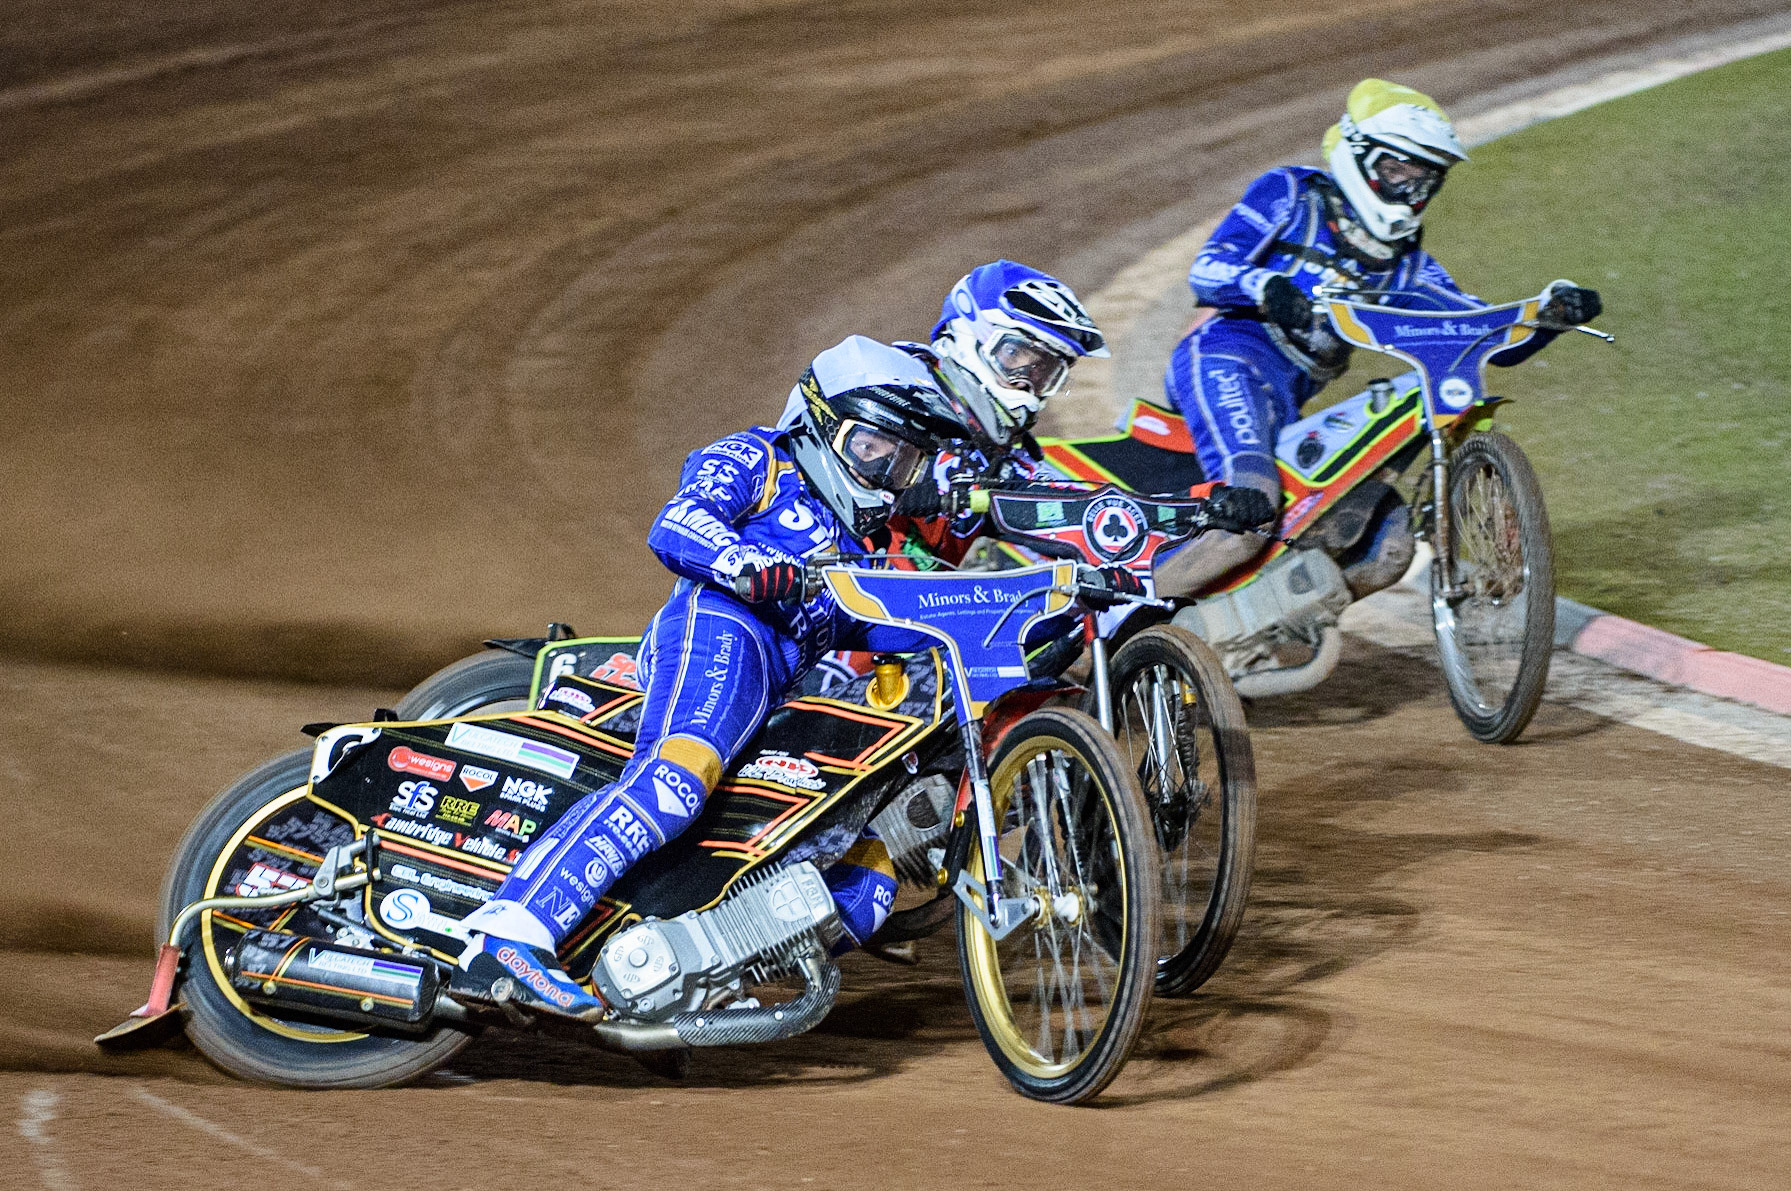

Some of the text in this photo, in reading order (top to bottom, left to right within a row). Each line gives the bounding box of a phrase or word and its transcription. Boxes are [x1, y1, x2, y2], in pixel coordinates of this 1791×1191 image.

[918, 585, 1029, 609] Minors & Brad
[713, 630, 738, 665] Brady
[705, 665, 728, 682] &
[690, 682, 724, 730] Minors
[410, 755, 453, 773] wesigns
[462, 767, 493, 780] ROCOL
[501, 776, 553, 805] NGK
[653, 764, 700, 815] ROCOL
[441, 795, 480, 816] RRE
[522, 798, 546, 813] PLUGS
[371, 813, 454, 846] Cambridge
[484, 809, 537, 836] MAP
[497, 946, 575, 1007] daytona
